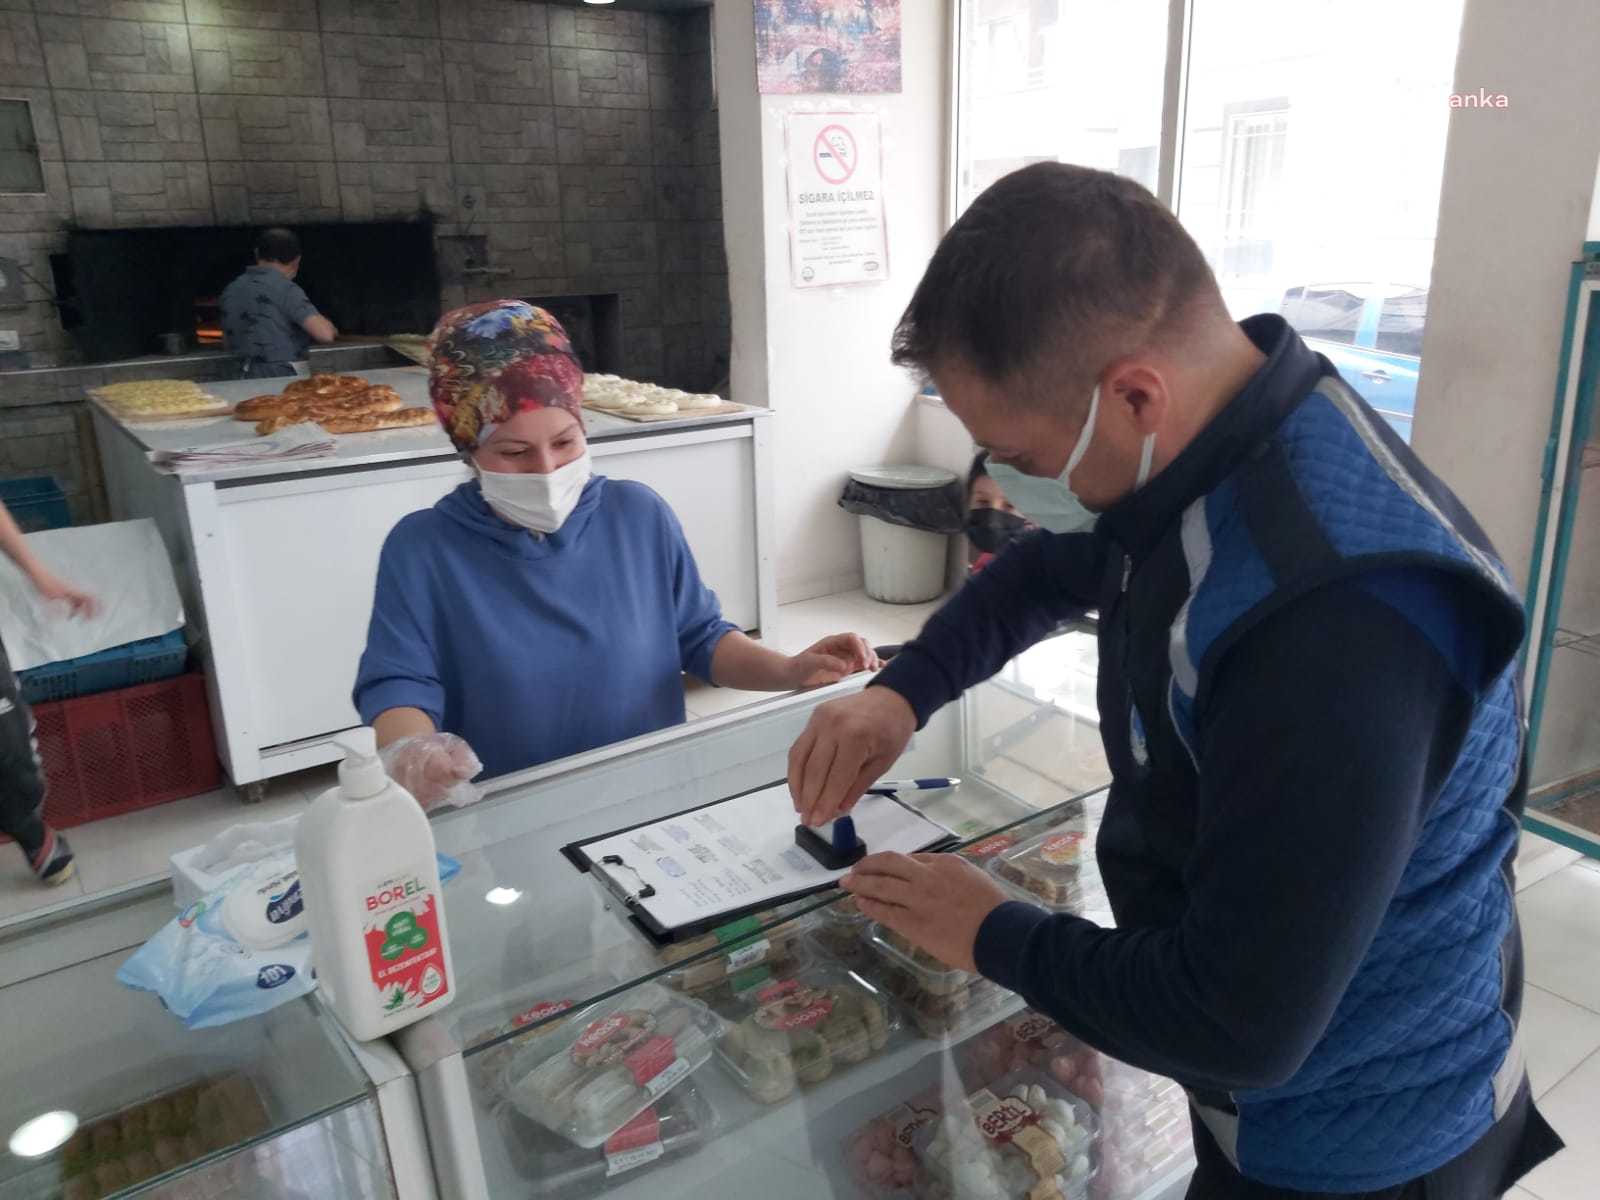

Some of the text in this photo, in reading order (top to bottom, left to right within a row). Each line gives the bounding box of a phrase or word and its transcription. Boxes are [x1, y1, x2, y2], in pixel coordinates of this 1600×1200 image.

[799, 190, 875, 204] SİGARA İÇİLMEZ
[366, 878, 426, 911] BOREL
